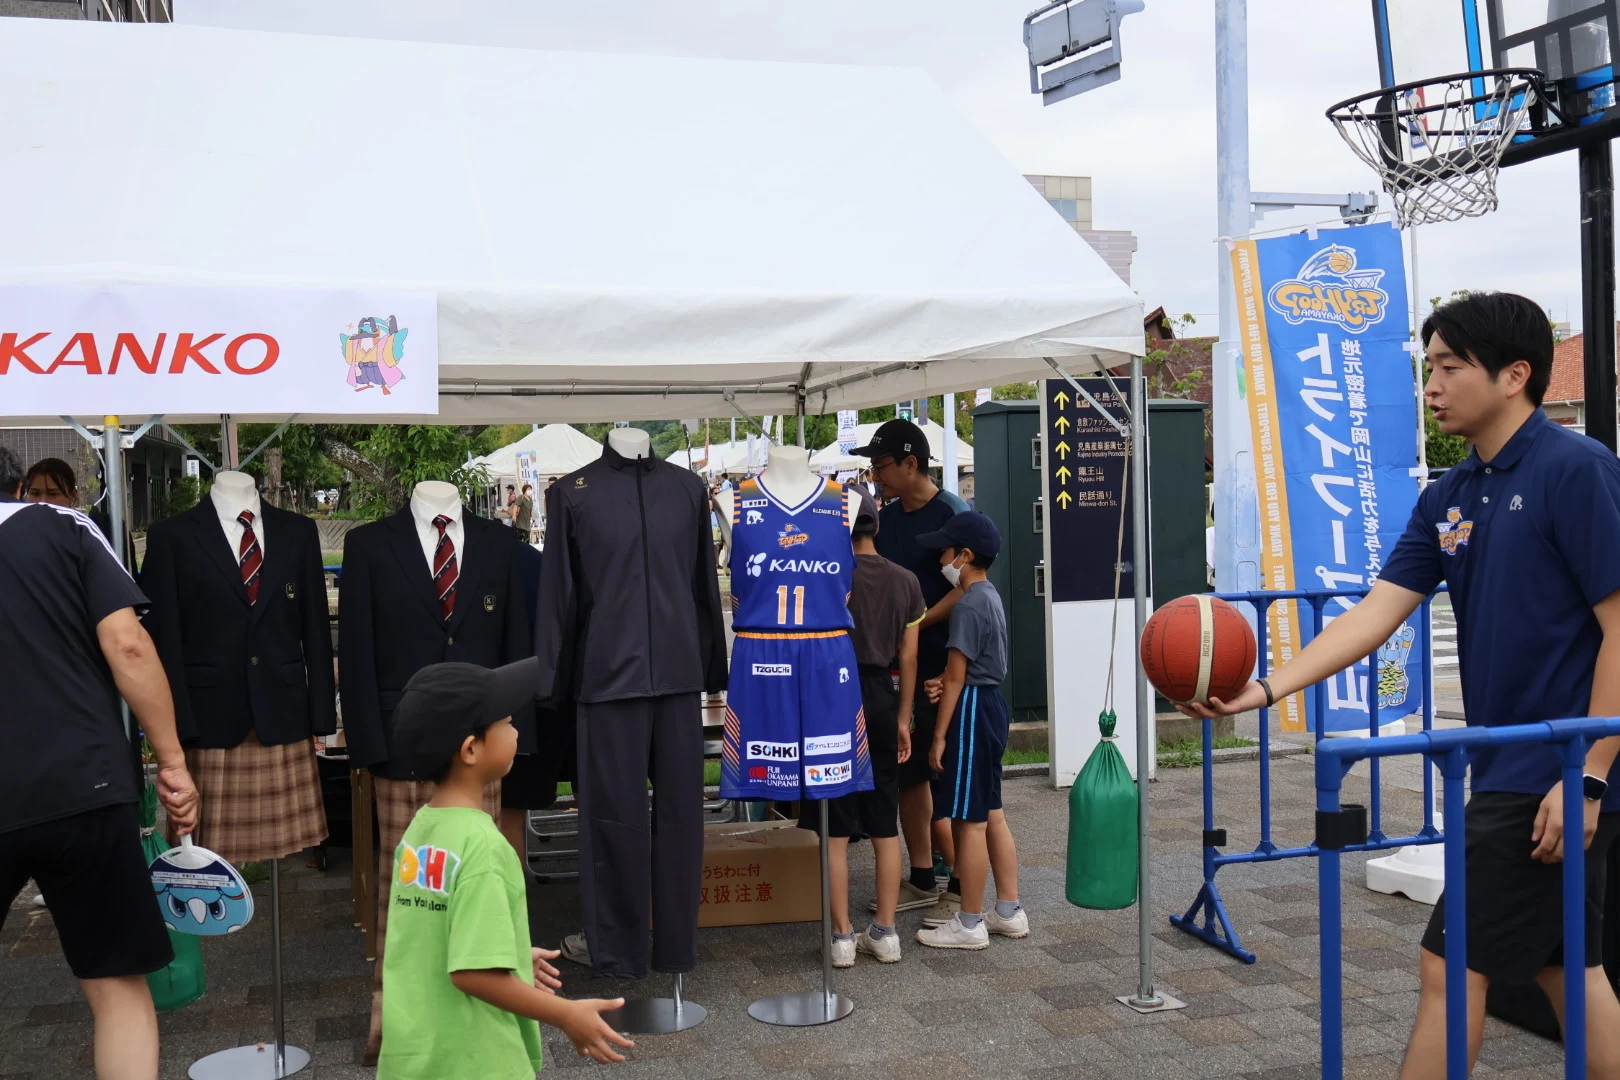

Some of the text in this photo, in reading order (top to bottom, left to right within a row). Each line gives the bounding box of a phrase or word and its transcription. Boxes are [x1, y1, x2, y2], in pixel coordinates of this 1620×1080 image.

[0, 332, 280, 375] KANKO
[1077, 426, 1100, 434] Kurashiki
[1077, 451, 1091, 459] Kojima
[1079, 491, 1112, 501] 民話通り
[769, 559, 841, 574] KANKO
[776, 585, 805, 625] 11
[751, 744, 797, 759] SOHKI
[767, 773, 799, 781] OKAYAMA
[703, 863, 761, 879] うちわに付
